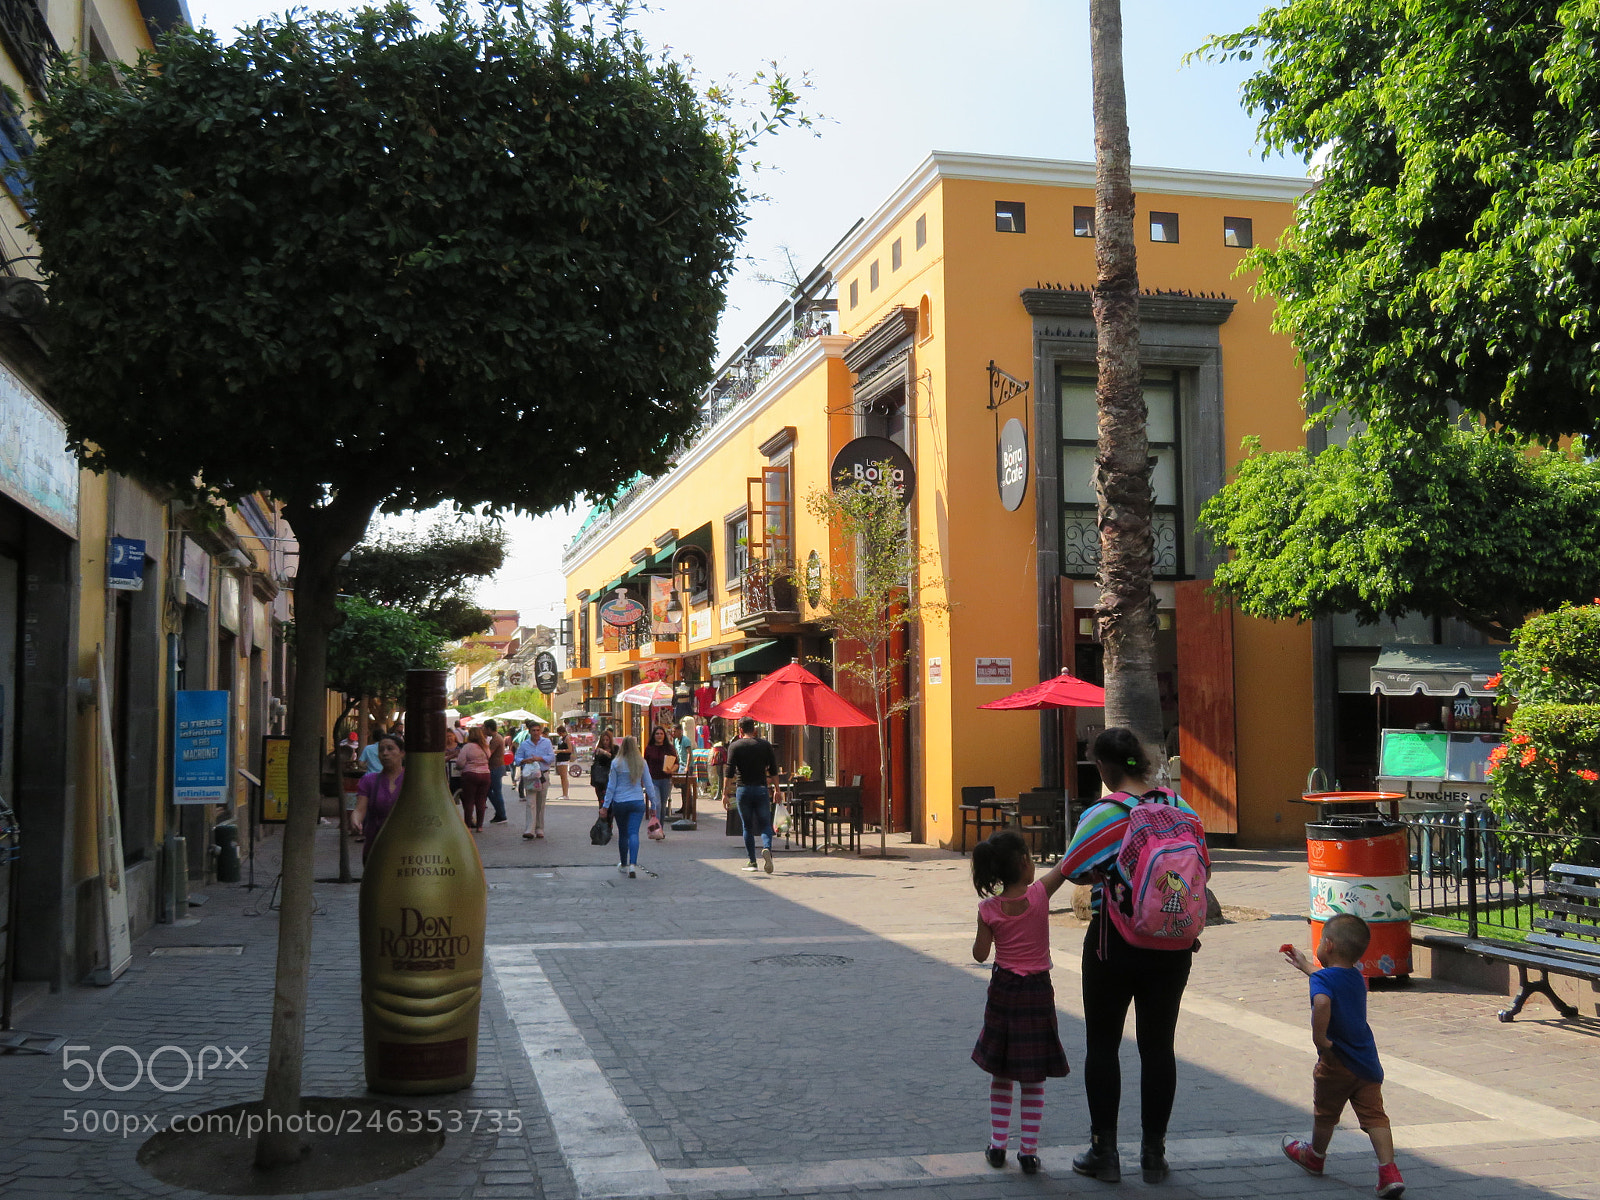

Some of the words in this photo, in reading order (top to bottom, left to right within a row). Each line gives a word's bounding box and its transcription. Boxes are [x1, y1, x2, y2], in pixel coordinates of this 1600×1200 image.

[1003, 447, 1022, 469] Borra
[1005, 463, 1024, 485] Café
[190, 718, 224, 730] TIENES
[179, 729, 223, 738] infinitum
[177, 789, 221, 797] infinitum
[1408, 790, 1469, 802] LUNCHES
[400, 855, 451, 866] TEQUILA
[397, 866, 456, 878] REPOSADO
[379, 926, 470, 959] ROBERTO
